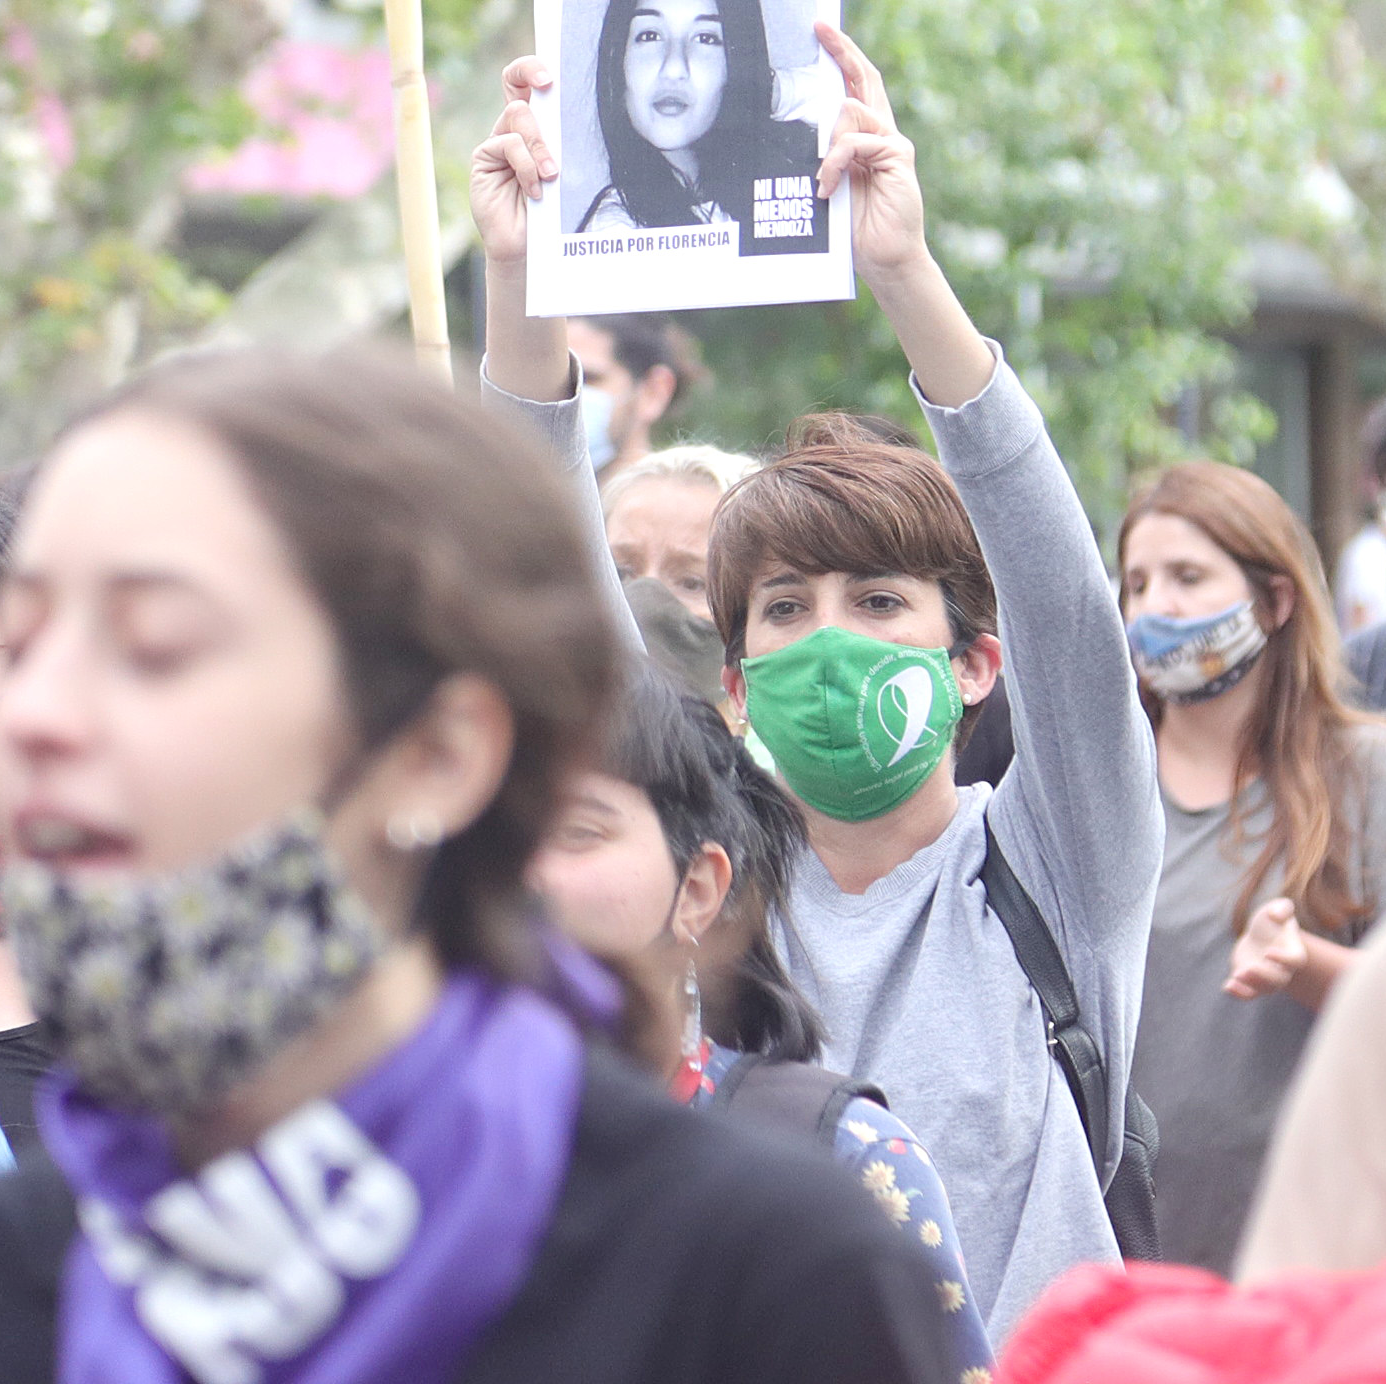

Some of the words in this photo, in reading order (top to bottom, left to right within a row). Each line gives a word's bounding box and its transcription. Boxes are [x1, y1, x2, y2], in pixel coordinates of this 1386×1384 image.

[754, 178, 773, 201] NI
[775, 175, 813, 199] UNA
[753, 197, 814, 222] MENOS
[753, 219, 814, 239] MENDOZA
[563, 238, 624, 257] JUSTICIA
[627, 236, 654, 253] POR
[658, 231, 731, 251] FLORENCIA
